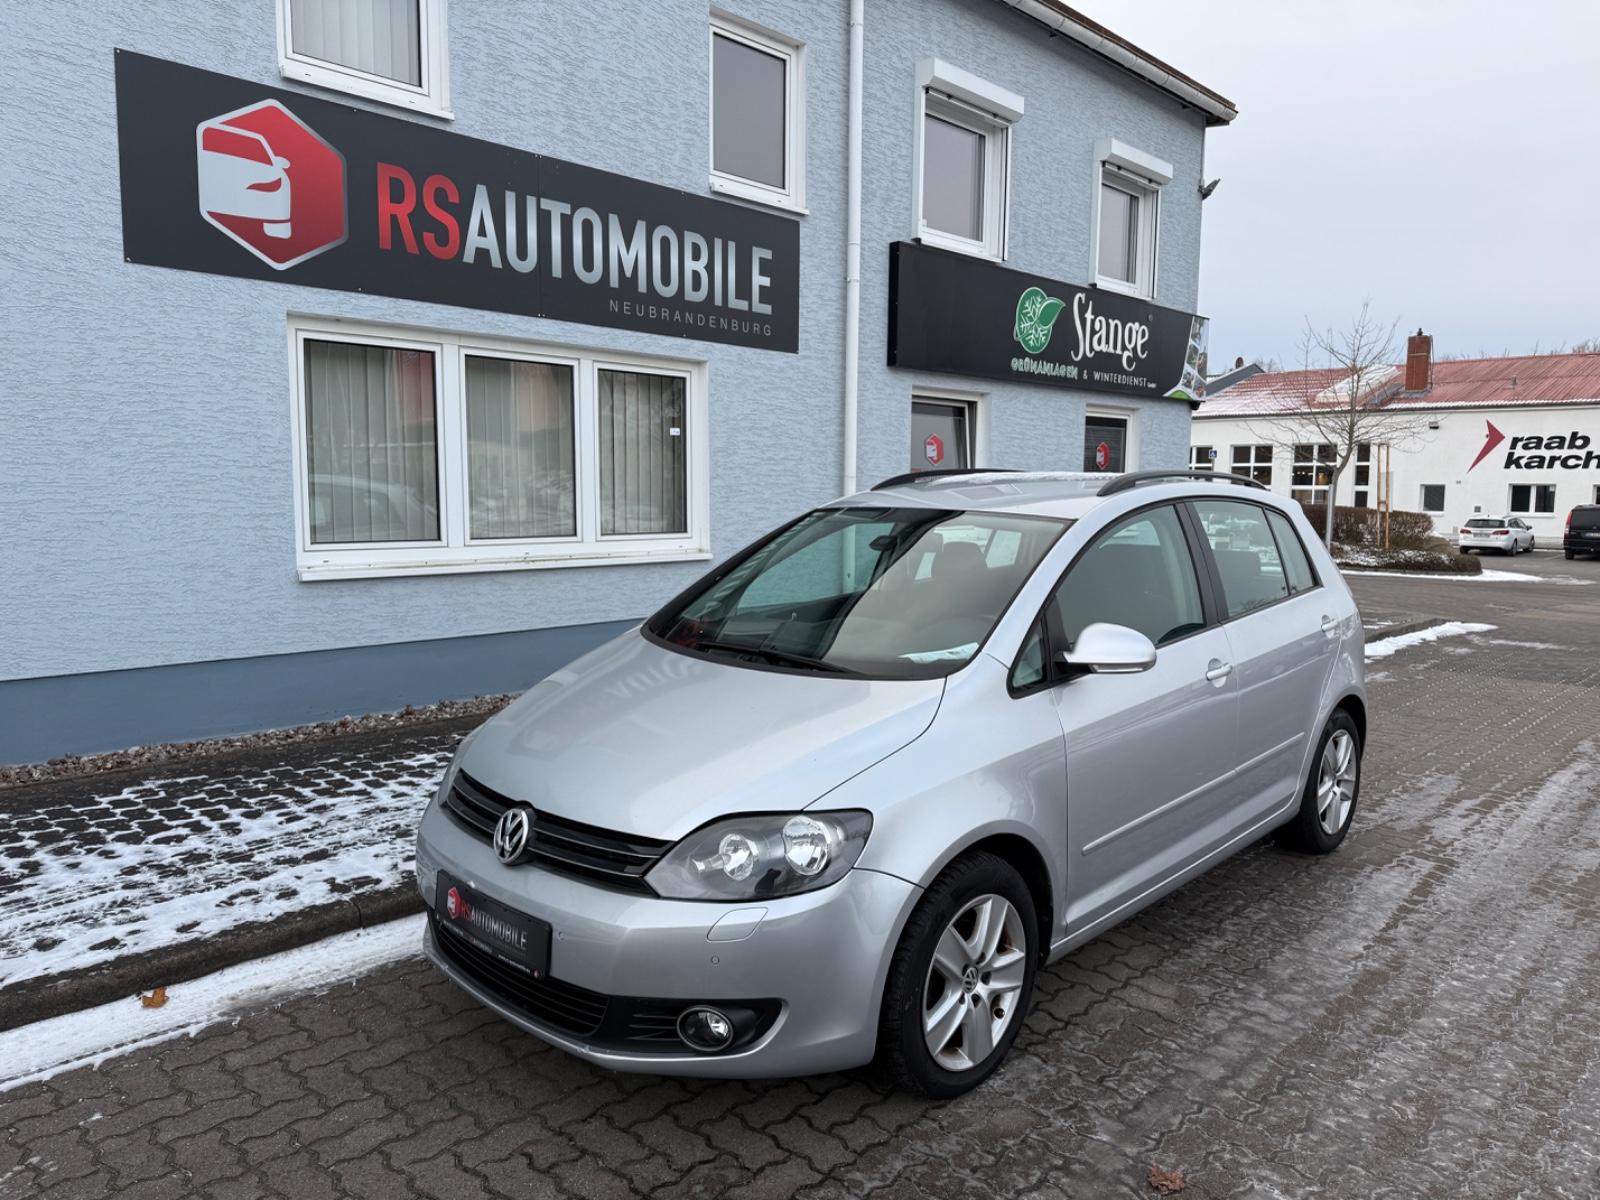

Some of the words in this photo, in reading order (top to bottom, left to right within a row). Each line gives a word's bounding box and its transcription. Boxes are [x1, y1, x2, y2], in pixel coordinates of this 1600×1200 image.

[609, 299, 772, 337] NEUBRANDENBURG
[1070, 291, 1149, 372] Stange
[1082, 369, 1089, 380] &
[1093, 370, 1147, 388] WINTERDIENST
[1508, 431, 1591, 451] raab
[1503, 450, 1600, 470] karch
